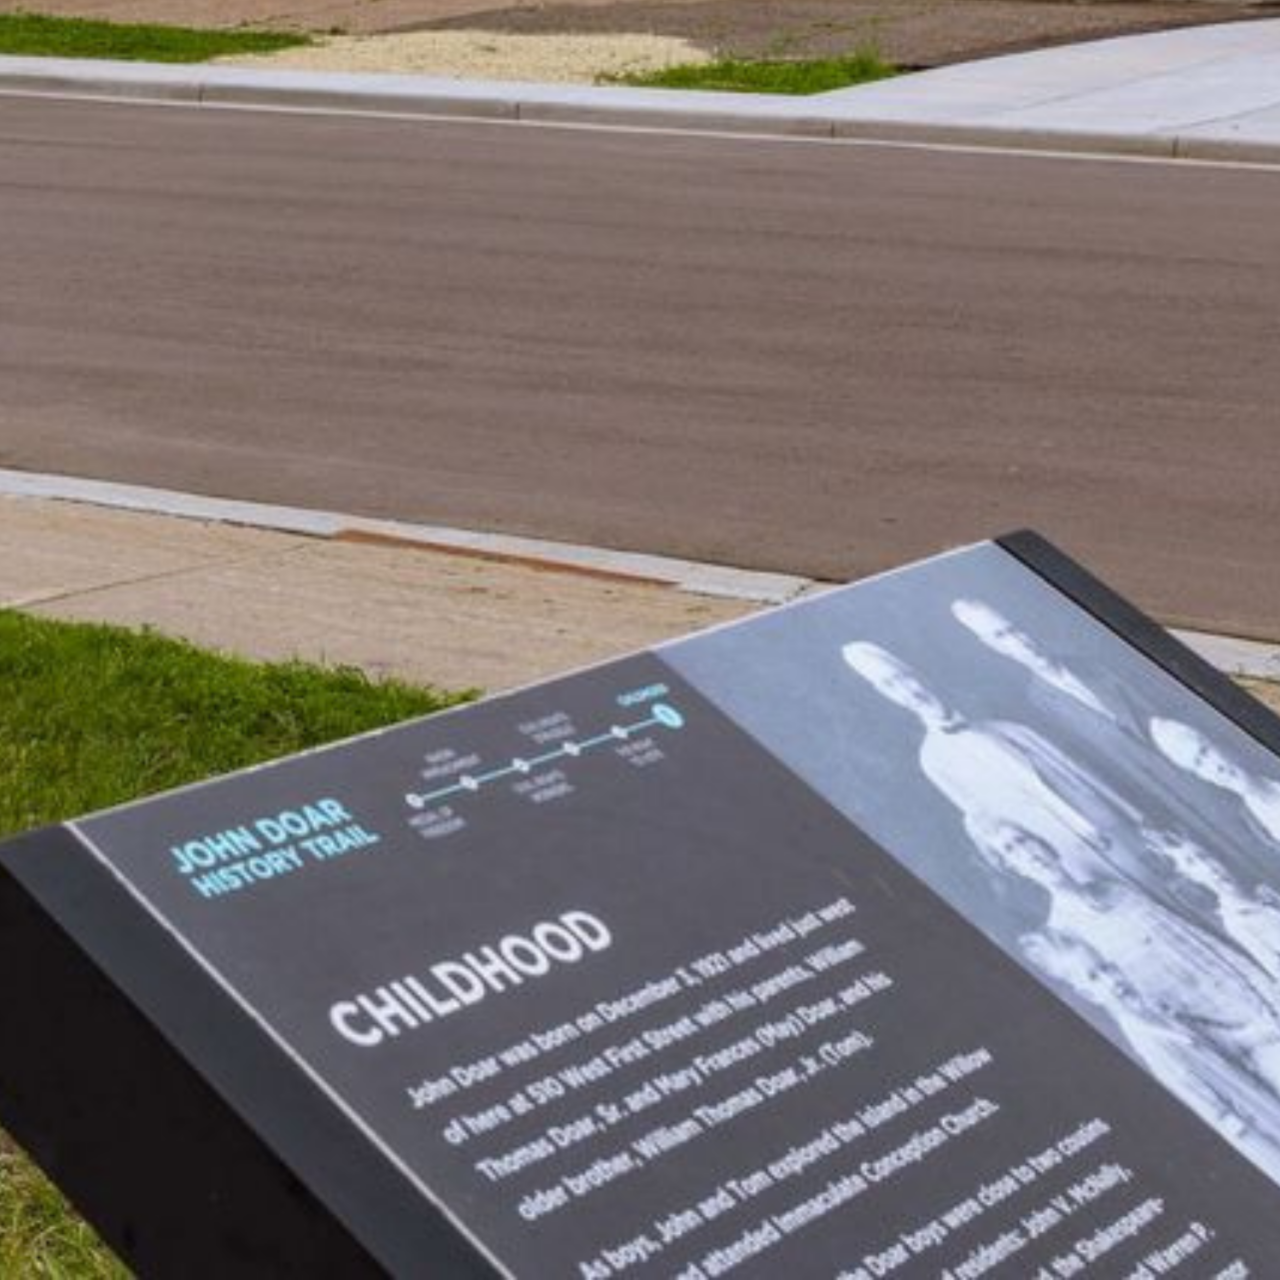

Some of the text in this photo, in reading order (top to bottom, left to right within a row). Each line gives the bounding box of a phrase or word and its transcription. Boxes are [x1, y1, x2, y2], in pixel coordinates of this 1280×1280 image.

[170, 826, 263, 874] JOHN
[254, 798, 352, 844] DOAR
[191, 824, 379, 898] HISTORY TRAIL
[330, 910, 611, 1046] CHILDHOOD
[407, 1077, 458, 1109] John
[449, 1056, 501, 1088] Doar
[498, 1041, 539, 1067] was
[530, 1022, 581, 1051] born
[576, 1012, 604, 1033] on
[595, 976, 682, 1023] December
[727, 938, 761, 964] and
[751, 922, 797, 951] lived
[816, 897, 856, 922] west
[443, 939, 865, 1145] of here at 510 West First Street with his parents, William
[475, 1137, 556, 1181] Thomas
[547, 1116, 606, 1148] Doar,
[595, 1103, 629, 1124] Sr.
[623, 1082, 662, 1112] and
[652, 1066, 703, 1095] Mary
[795, 997, 846, 1025] Doar,
[838, 979, 872, 1006] and
[861, 972, 893, 992] his
[518, 1185, 569, 1221] older
[561, 1152, 644, 1196] brother,
[632, 1118, 703, 1159] William
[693, 1087, 764, 1127] Thomas
[755, 1067, 808, 1097] Doar,
[601, 1235, 662, 1270] boys,
[654, 1209, 703, 1244] John
[697, 1186, 736, 1220] and
[725, 1170, 774, 1200] Tom
[767, 1130, 841, 1180] explored
[831, 1119, 866, 1143] the
[855, 1092, 909, 1128] island
[899, 1087, 924, 1105] in
[914, 1073, 948, 1096] the
[937, 1047, 992, 1082] Willow
[701, 1220, 782, 1277] attended
[771, 1174, 868, 1233] Immaculate
[860, 1127, 949, 1182] Conception
[939, 1097, 1000, 1135] Church.
[862, 1243, 910, 1277] Doar
[899, 1220, 948, 1253] boys
[940, 1198, 984, 1229] were
[977, 1174, 1020, 1207] close
[1009, 1165, 1036, 1184] to
[1027, 1147, 1063, 1174] two
[1057, 1117, 1111, 1157] cousins
[1020, 1207, 1062, 1239] John
[1051, 1253, 1085, 1279] the
[1143, 1233, 1201, 1274] Warren
